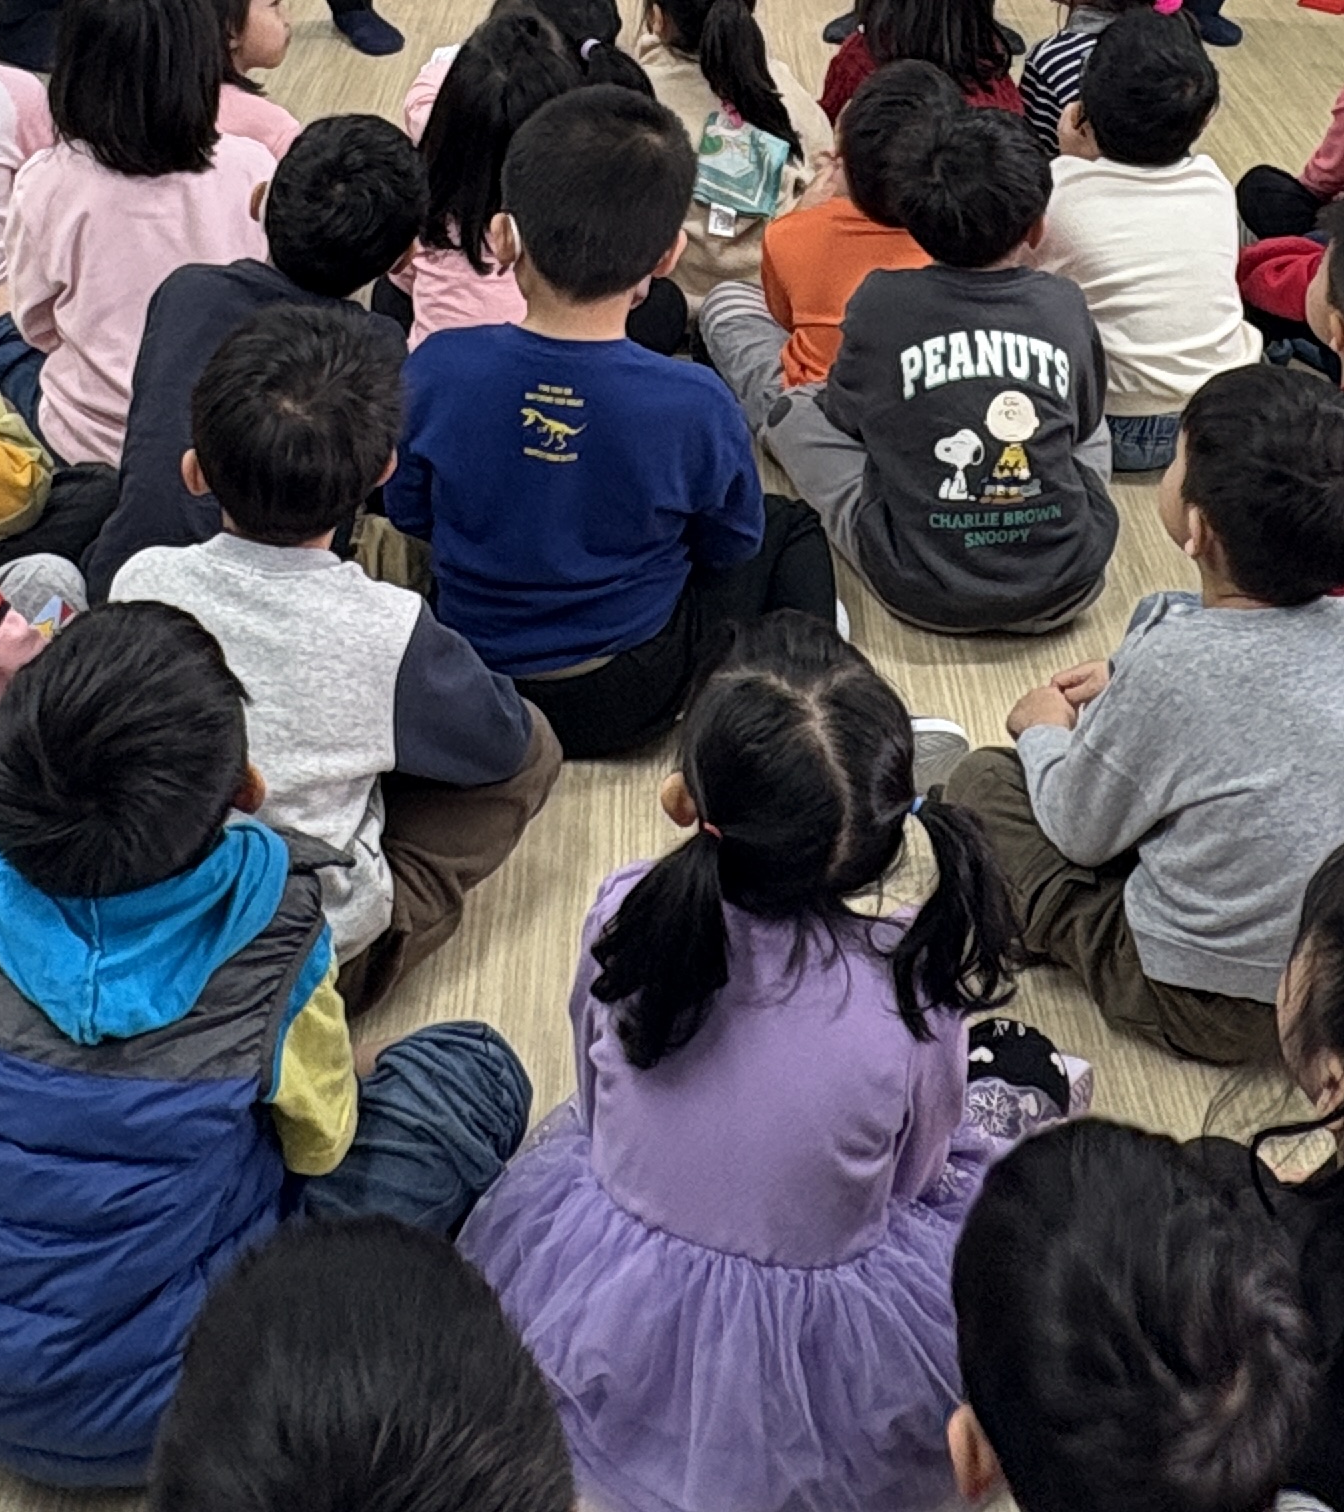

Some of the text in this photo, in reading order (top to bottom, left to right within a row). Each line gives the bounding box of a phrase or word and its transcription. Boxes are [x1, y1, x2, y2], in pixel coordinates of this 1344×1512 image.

[900, 329, 1071, 401] PEANUTS
[928, 503, 1063, 530] CHARLIE BROWN
[963, 528, 1031, 550] SNOOPY
